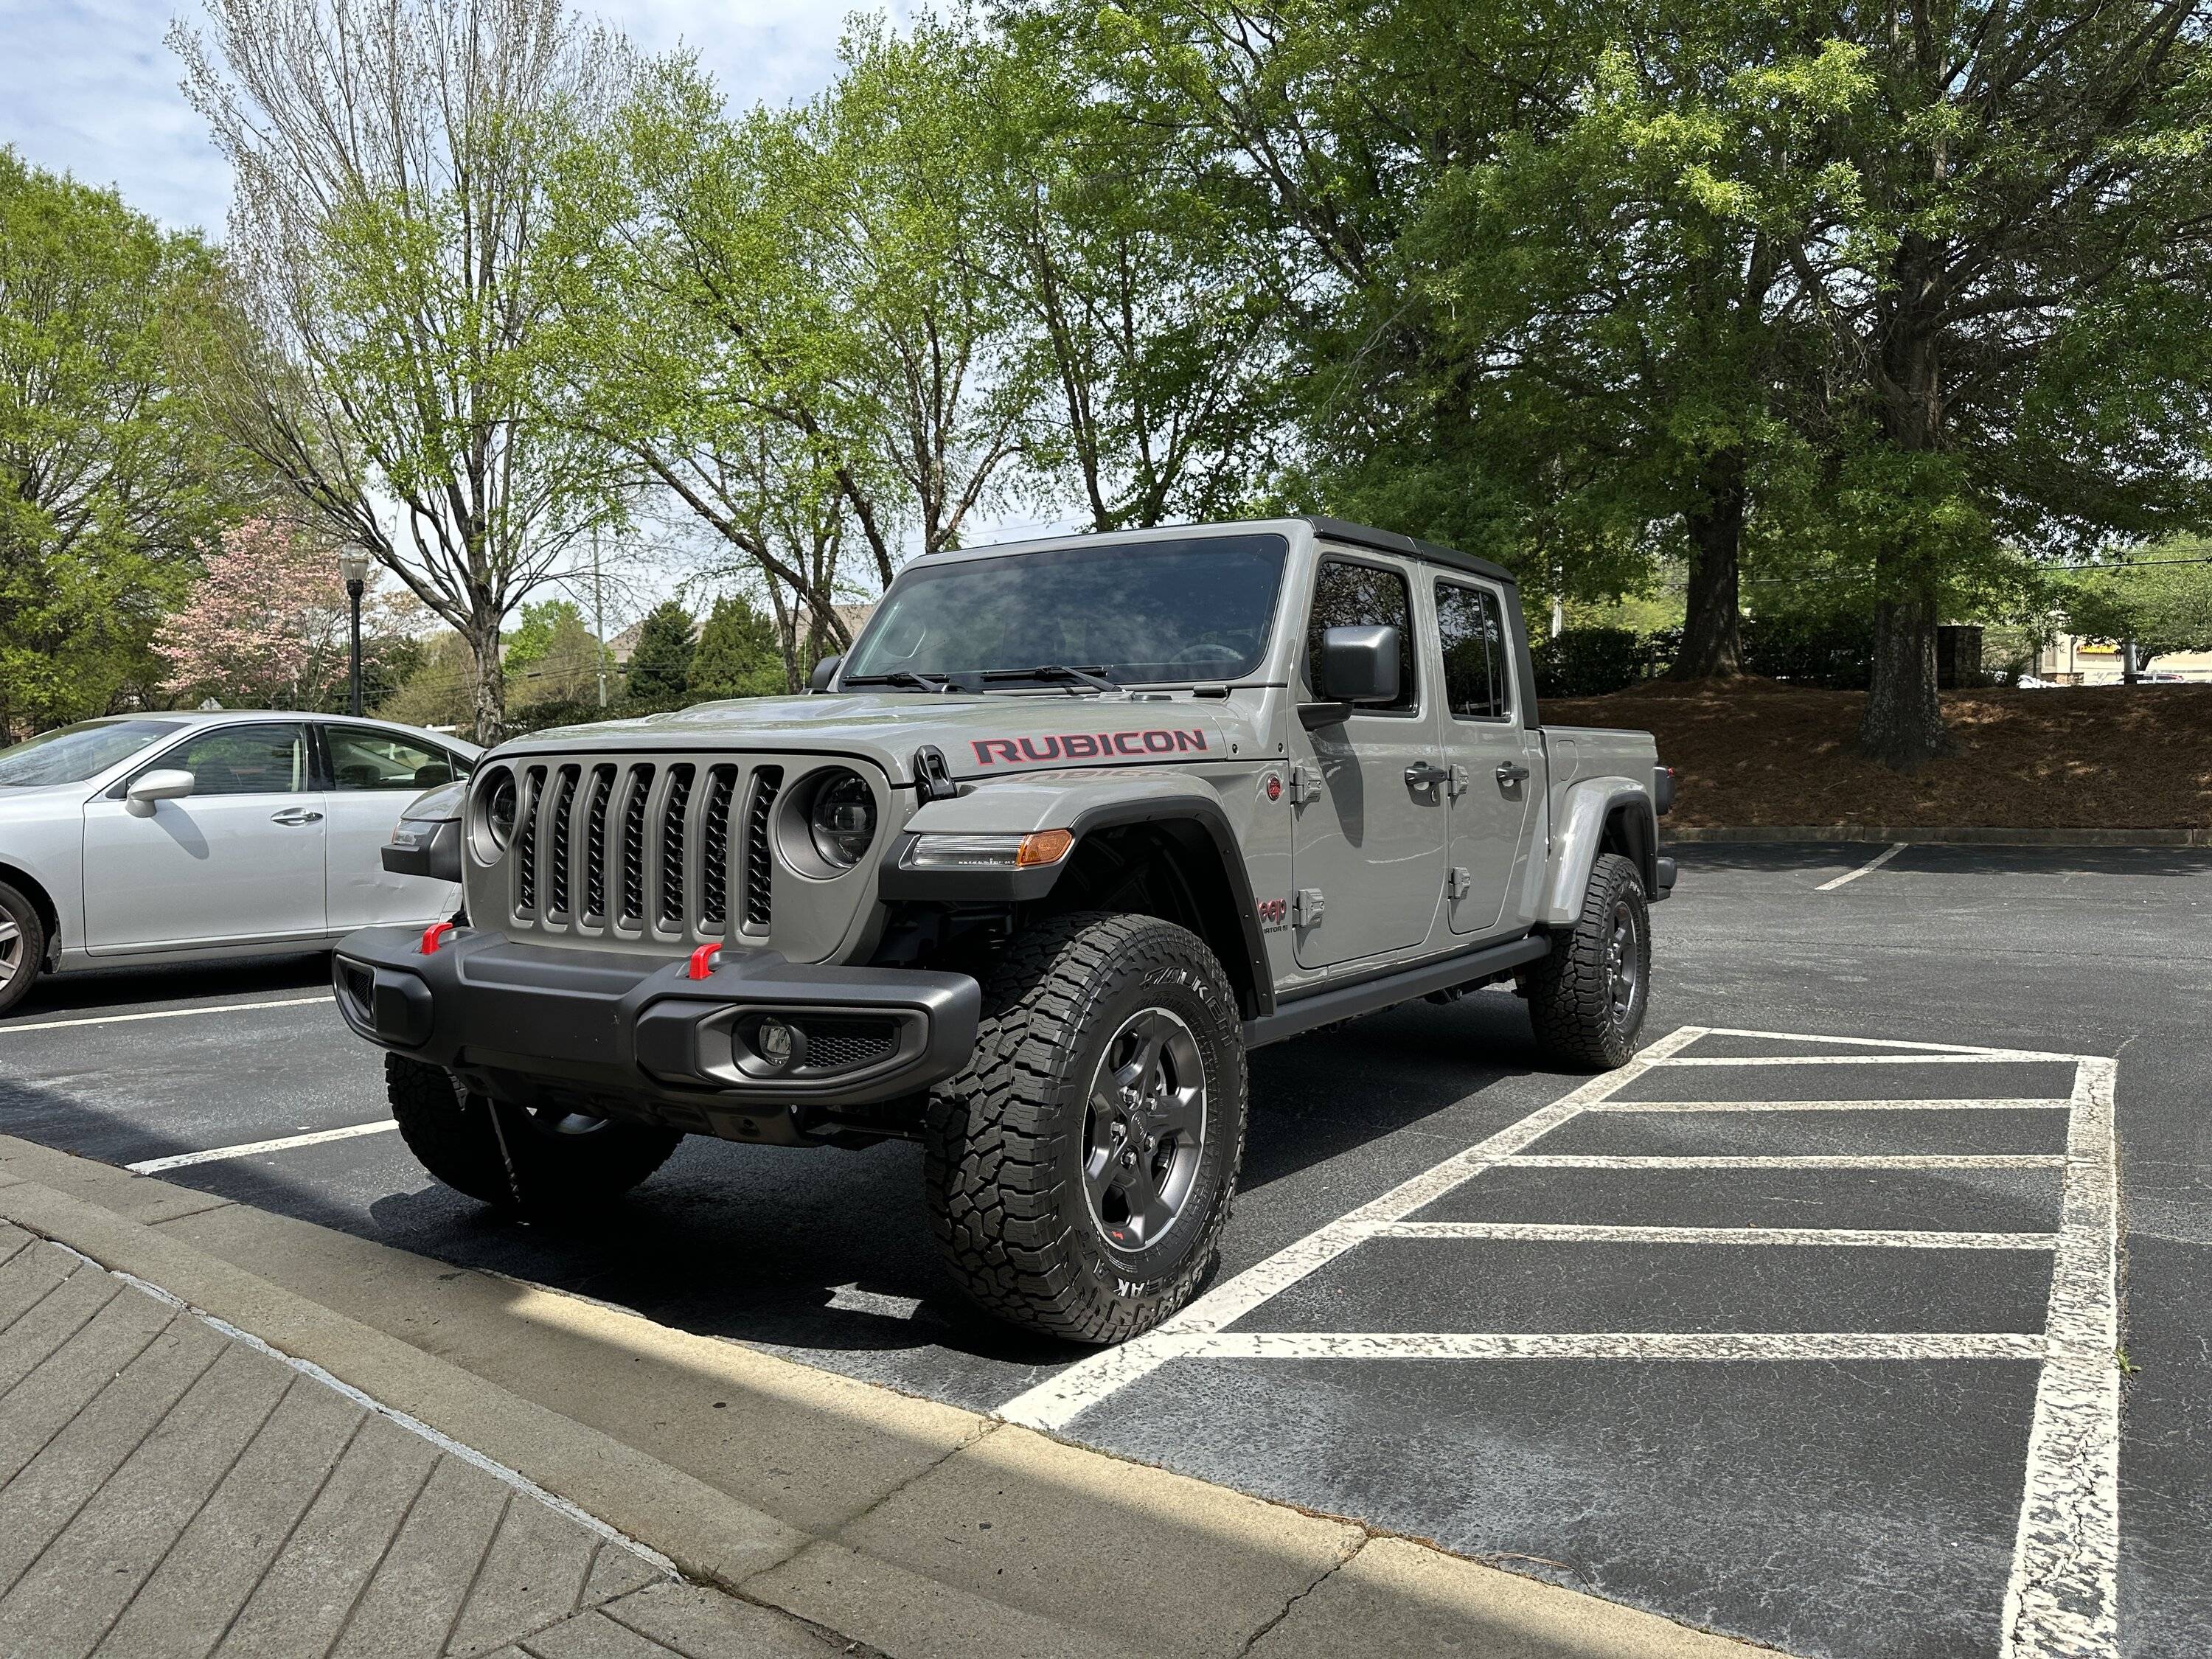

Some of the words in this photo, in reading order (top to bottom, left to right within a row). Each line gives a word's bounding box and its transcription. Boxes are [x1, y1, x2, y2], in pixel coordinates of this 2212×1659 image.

[972, 729, 1208, 766] RUBICON
[1256, 897, 1287, 925] eep
[1263, 925, 1282, 933] IATOR
[1138, 966, 1234, 1047] FALKEN
